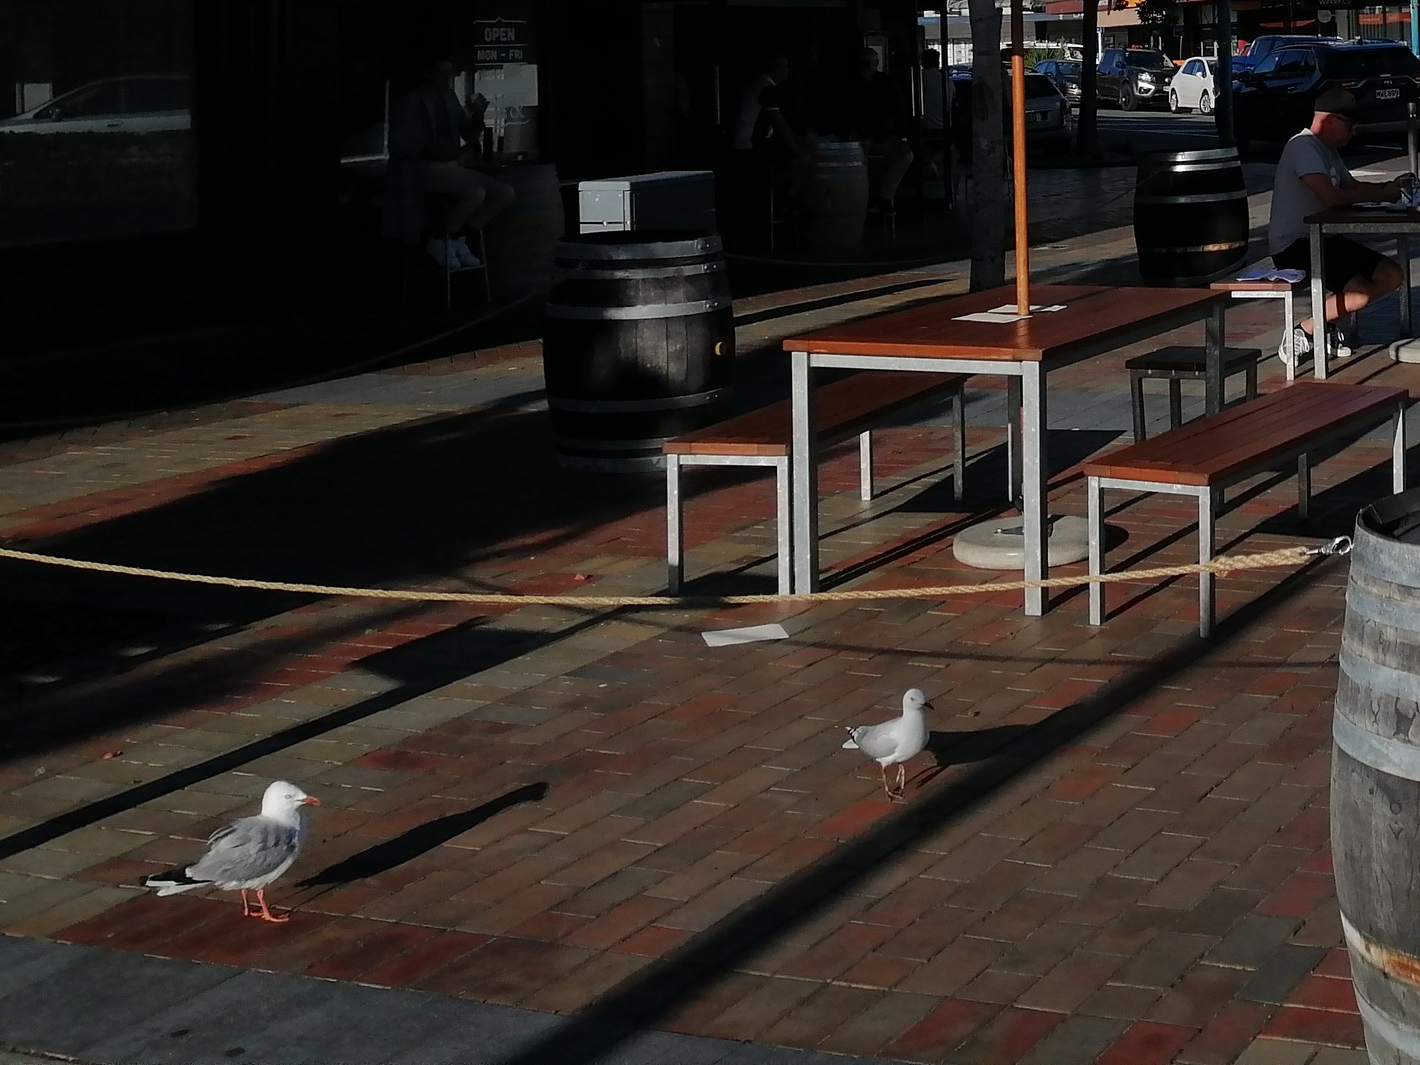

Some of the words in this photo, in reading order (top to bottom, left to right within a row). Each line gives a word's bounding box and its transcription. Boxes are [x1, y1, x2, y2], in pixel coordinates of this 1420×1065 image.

[484, 27, 516, 42] OPEN
[477, 50, 497, 61] MON
[509, 49, 523, 60] FRI
